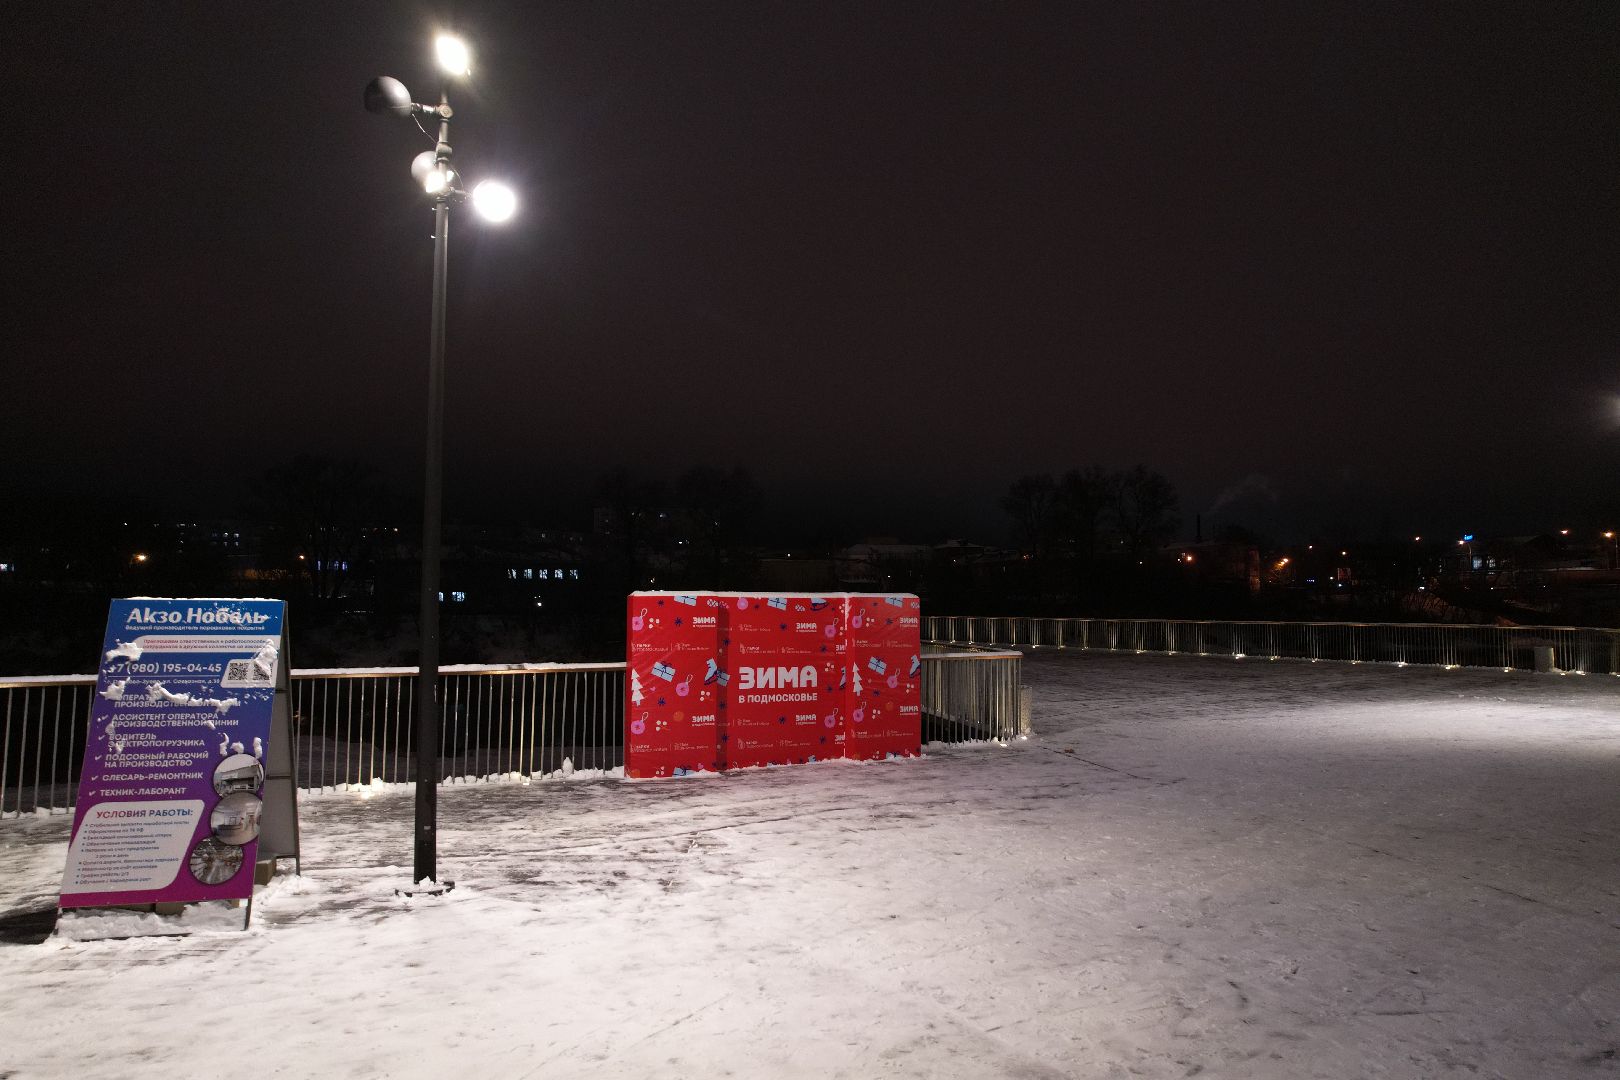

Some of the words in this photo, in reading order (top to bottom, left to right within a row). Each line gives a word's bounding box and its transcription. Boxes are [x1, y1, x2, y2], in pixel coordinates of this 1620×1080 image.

[127, 607, 182, 624] Акзо
[186, 607, 267, 624] Нобель
[692, 616, 716, 624] ЗИМА
[109, 663, 124, 672] +7
[127, 662, 159, 674] (980)
[162, 663, 222, 672] 195-04-45
[738, 665, 818, 690] ЗИМА
[747, 693, 818, 704] ПОДМОСКОВЬЕ
[899, 705, 919, 713] ЗИМА
[112, 713, 166, 721] АССИСТЕНТ
[691, 715, 715, 723] ЗИМА
[795, 713, 817, 721] ЗИМА
[109, 733, 156, 741] ВОДИТЕЛЬ
[105, 752, 165, 761] ПОДСОБНЫЙ
[167, 751, 208, 760] РАБОЧИЙ
[119, 759, 192, 768] ПРОИЗВОДСТВО
[102, 772, 203, 781] СЛЕСАРЬ-РЕМОНТНИК
[99, 787, 187, 796] ТЕХНИК-ЛАБОРАНТ
[96, 810, 146, 819] УСЛОВИЯ
[149, 808, 193, 817] РАБОТЫ:
